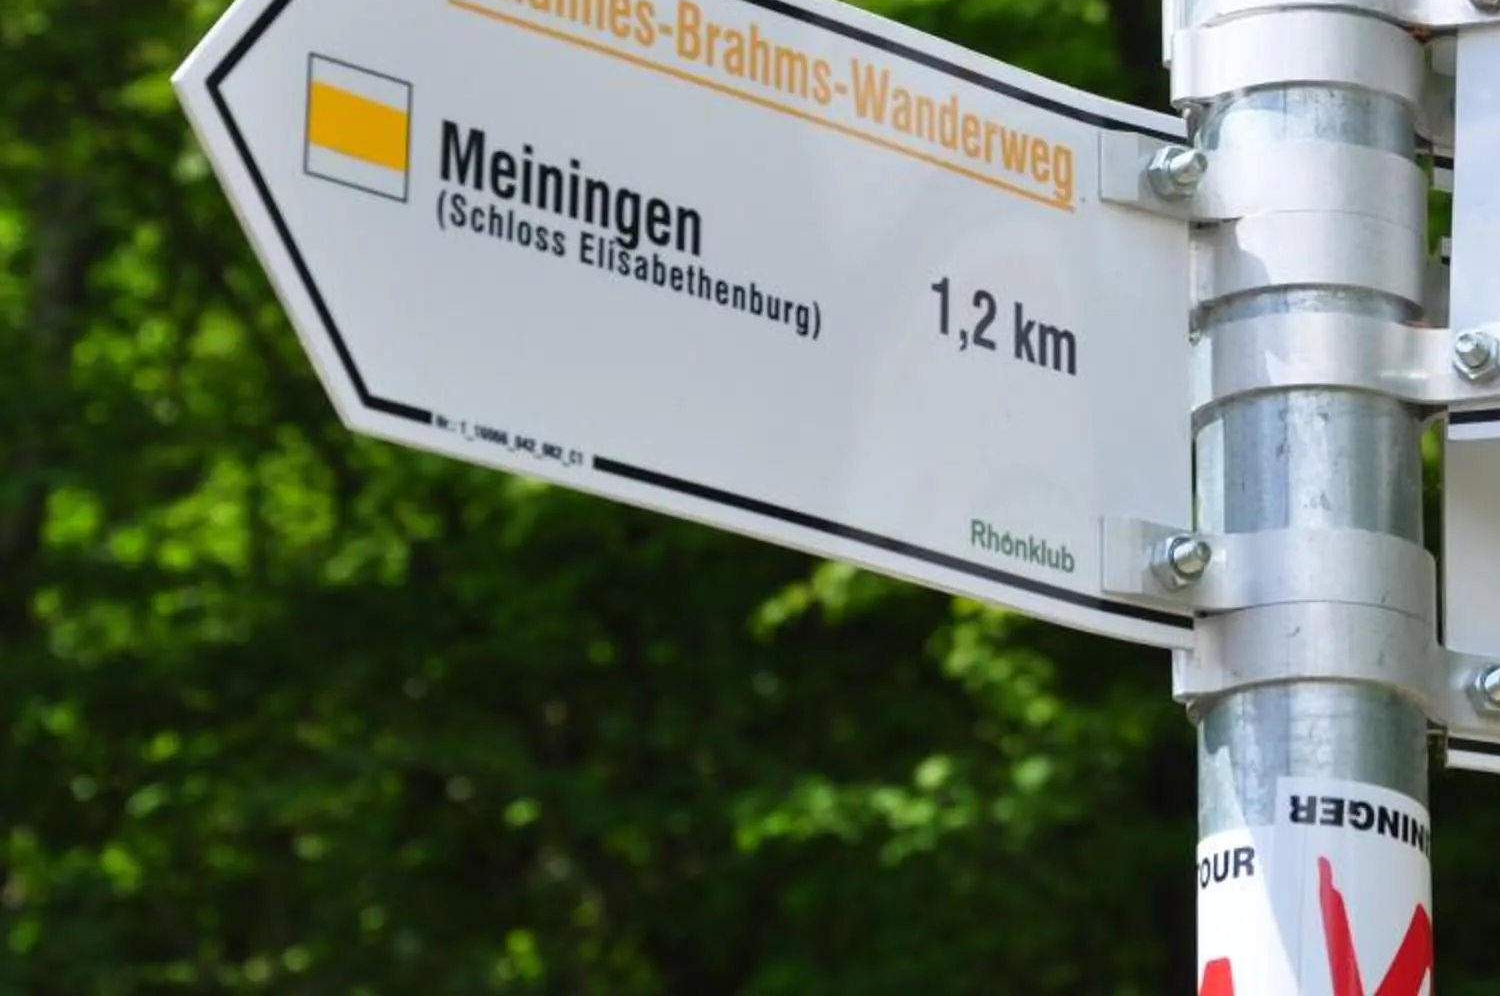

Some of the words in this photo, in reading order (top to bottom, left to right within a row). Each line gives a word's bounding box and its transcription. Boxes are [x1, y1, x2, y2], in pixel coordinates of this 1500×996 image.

[440, 119, 702, 256] Meiningen
[436, 190, 566, 257] (Schloss
[579, 231, 821, 340] Elisabethenburg)
[931, 277, 997, 351] 1,2
[1014, 302, 1077, 376] km
[1198, 846, 1255, 890] OUR
